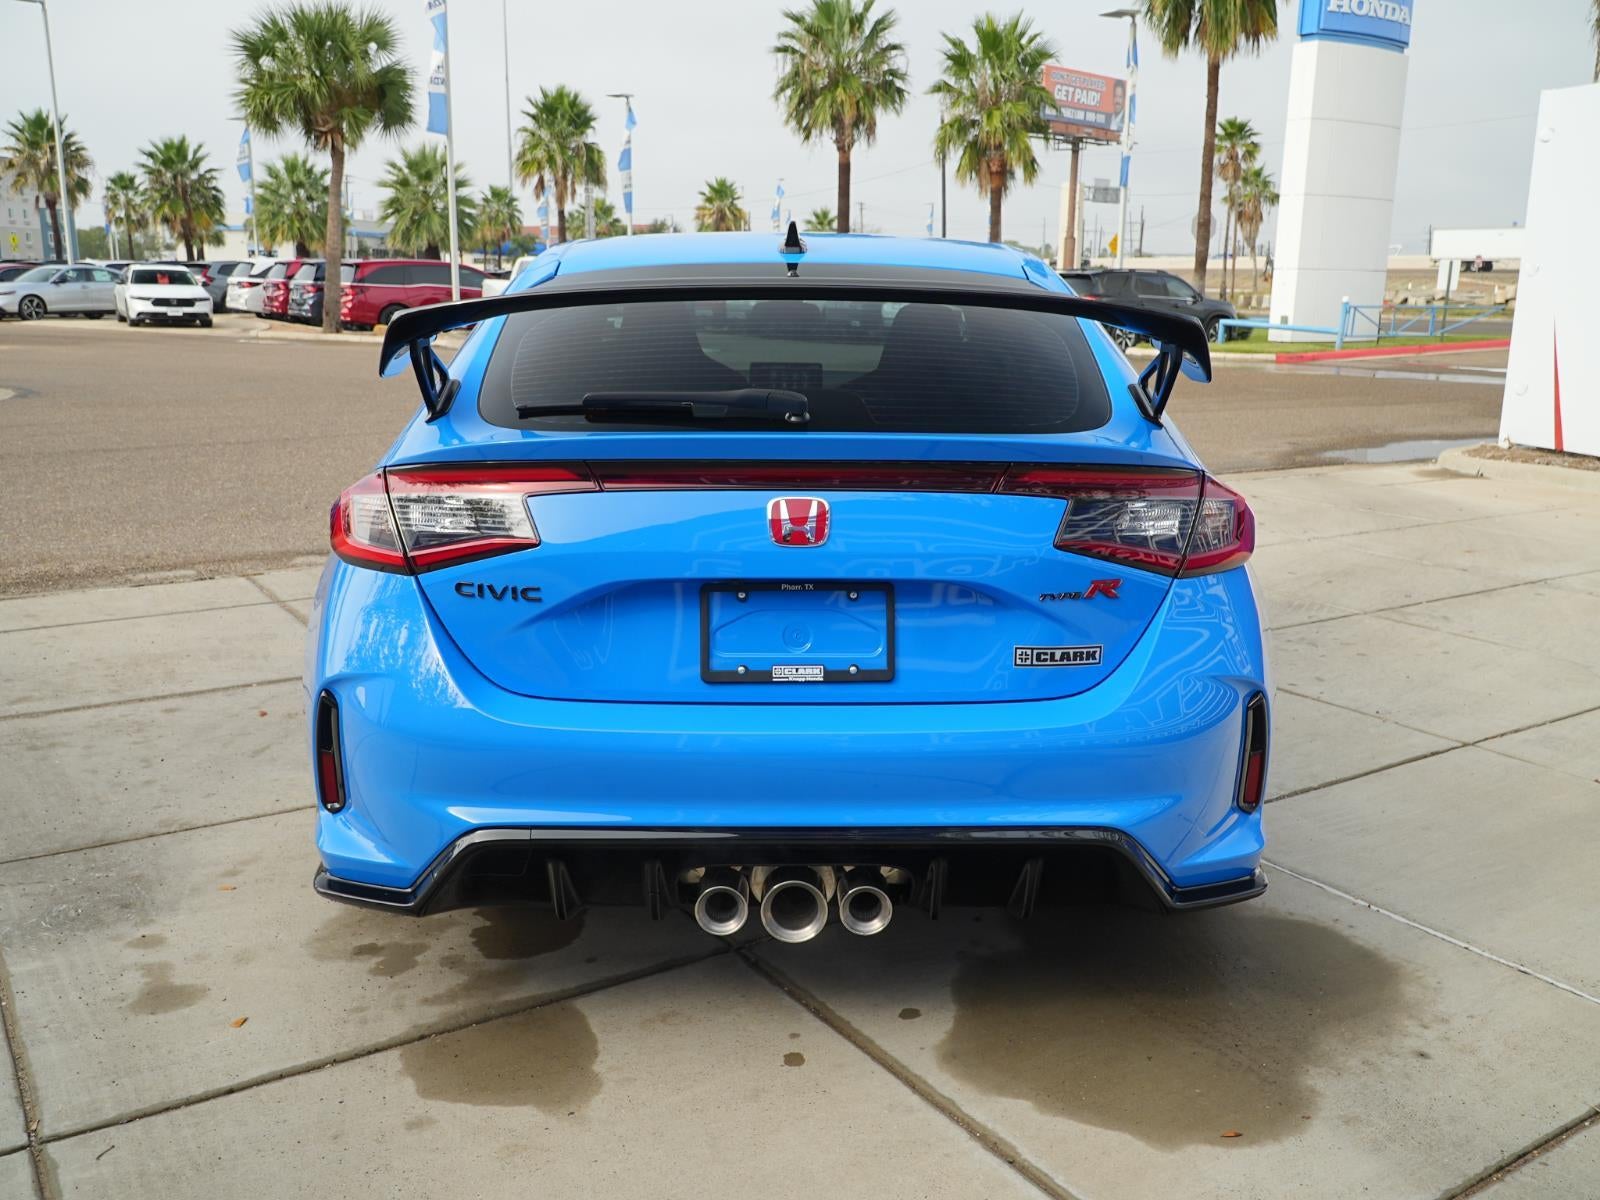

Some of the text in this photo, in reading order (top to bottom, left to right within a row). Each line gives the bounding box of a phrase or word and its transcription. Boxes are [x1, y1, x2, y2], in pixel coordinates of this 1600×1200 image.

[1327, 0, 1411, 25] HONDA
[1055, 84, 1101, 106] GET PAID!
[454, 581, 543, 603] CIVIC
[804, 583, 814, 591] TX
[1083, 578, 1122, 599] R
[1035, 650, 1098, 663] CLARK
